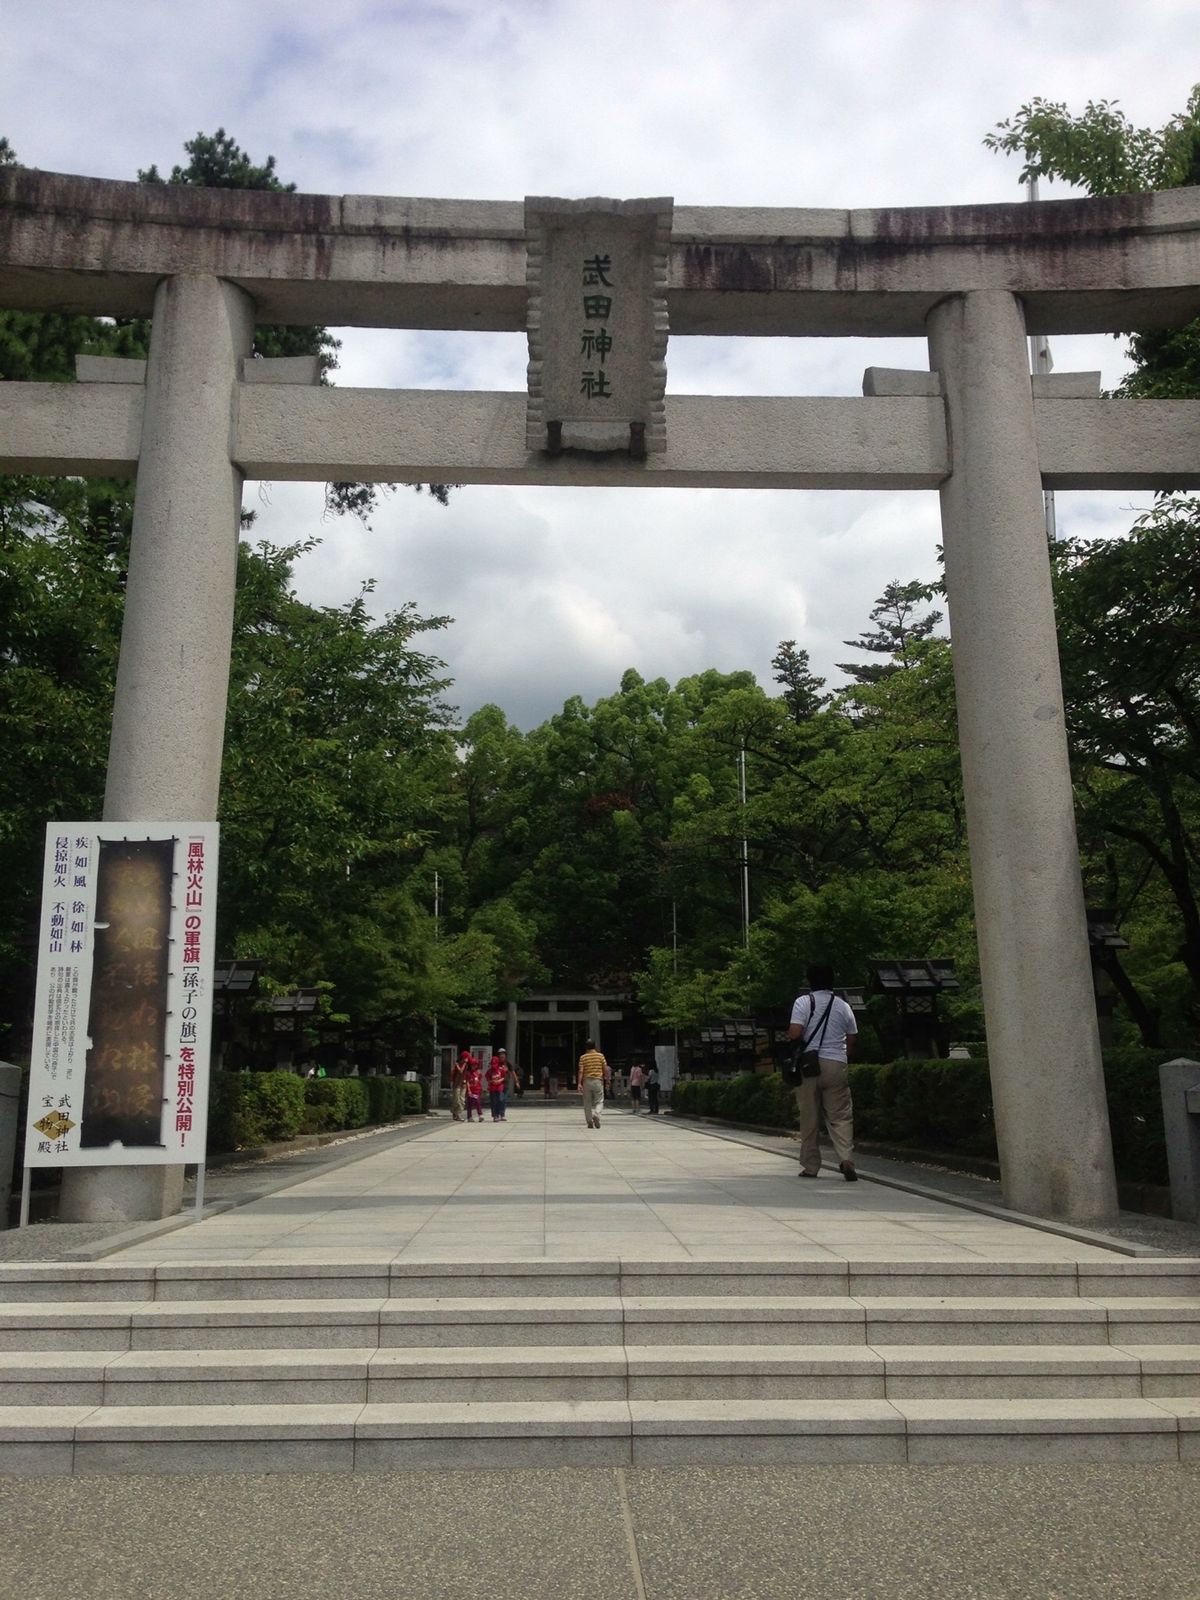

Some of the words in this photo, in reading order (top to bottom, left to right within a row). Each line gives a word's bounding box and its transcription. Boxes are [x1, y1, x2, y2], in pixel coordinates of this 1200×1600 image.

[580, 254, 614, 400] 武田神社
[54, 836, 69, 887] 侵掠如火
[73, 836, 88, 887] 疾如風
[49, 901, 65, 953] 不動如山
[70, 901, 85, 953] 徐如林
[37, 1094, 54, 1153] 宝物殿
[55, 1093, 72, 1153] 武田神社
